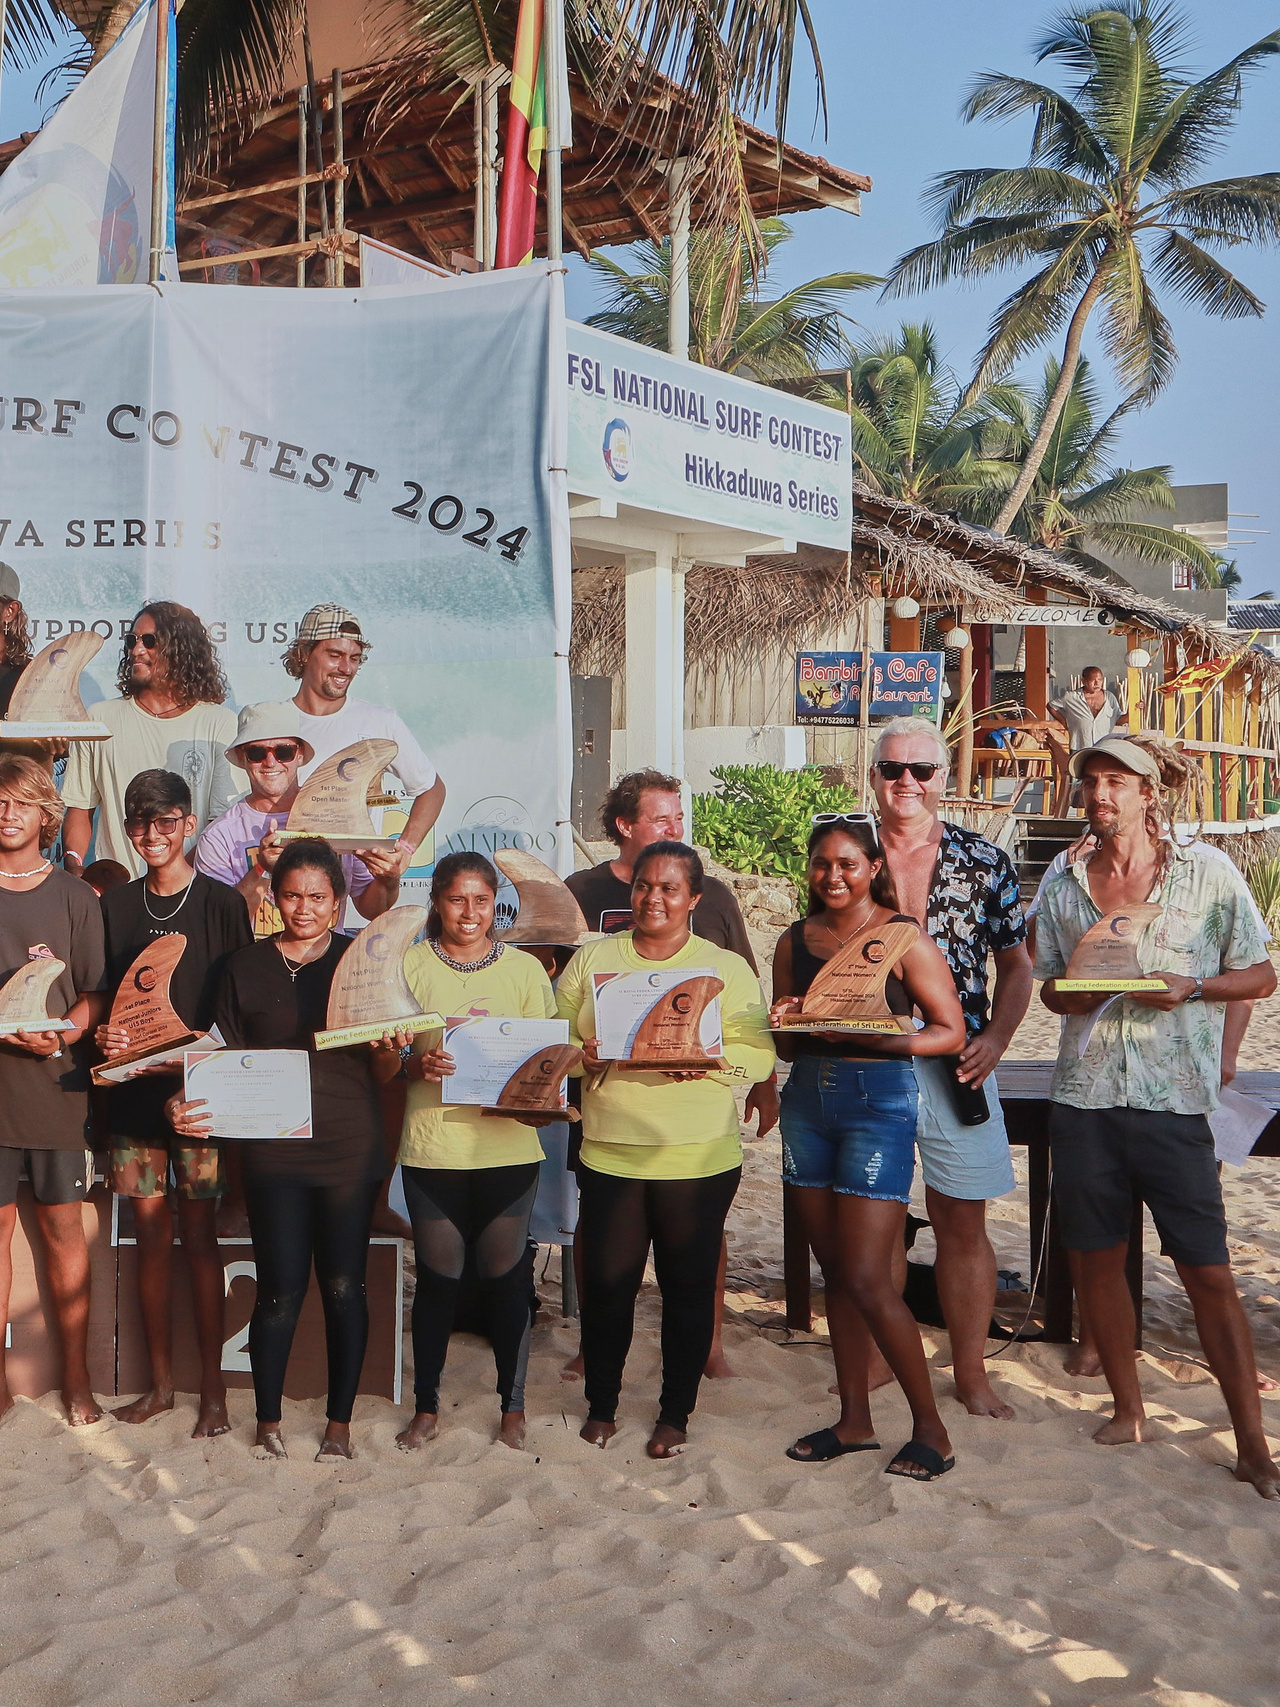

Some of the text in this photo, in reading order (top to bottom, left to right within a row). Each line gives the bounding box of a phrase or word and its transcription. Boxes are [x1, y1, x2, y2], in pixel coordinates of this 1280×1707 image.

[612, 366, 710, 427] NATIONAL
[715, 399, 763, 440] SURF
[768, 416, 843, 463] CONTEST
[106, 402, 380, 504] CONTEST
[390, 479, 531, 566] 2024
[684, 452, 840, 519] Hikkaduwa Series
[1001, 606, 1096, 623] WELCOME
[888, 658, 938, 683] Cafe
[850, 684, 934, 703] Rtaurant
[797, 716, 809, 724] Tel:
[352, 969, 363, 977] 1st
[341, 982, 367, 992] National
[134, 998, 151, 1007] Place
[118, 1006, 162, 1026] National Juniors
[140, 1016, 155, 1027] Boys
[321, 1034, 349, 1044] Surfing
[349, 1026, 390, 1039] Federation
[401, 1022, 412, 1030] Sri
[413, 1018, 435, 1028] Lanka
[872, 1022, 894, 1030] Lanka
